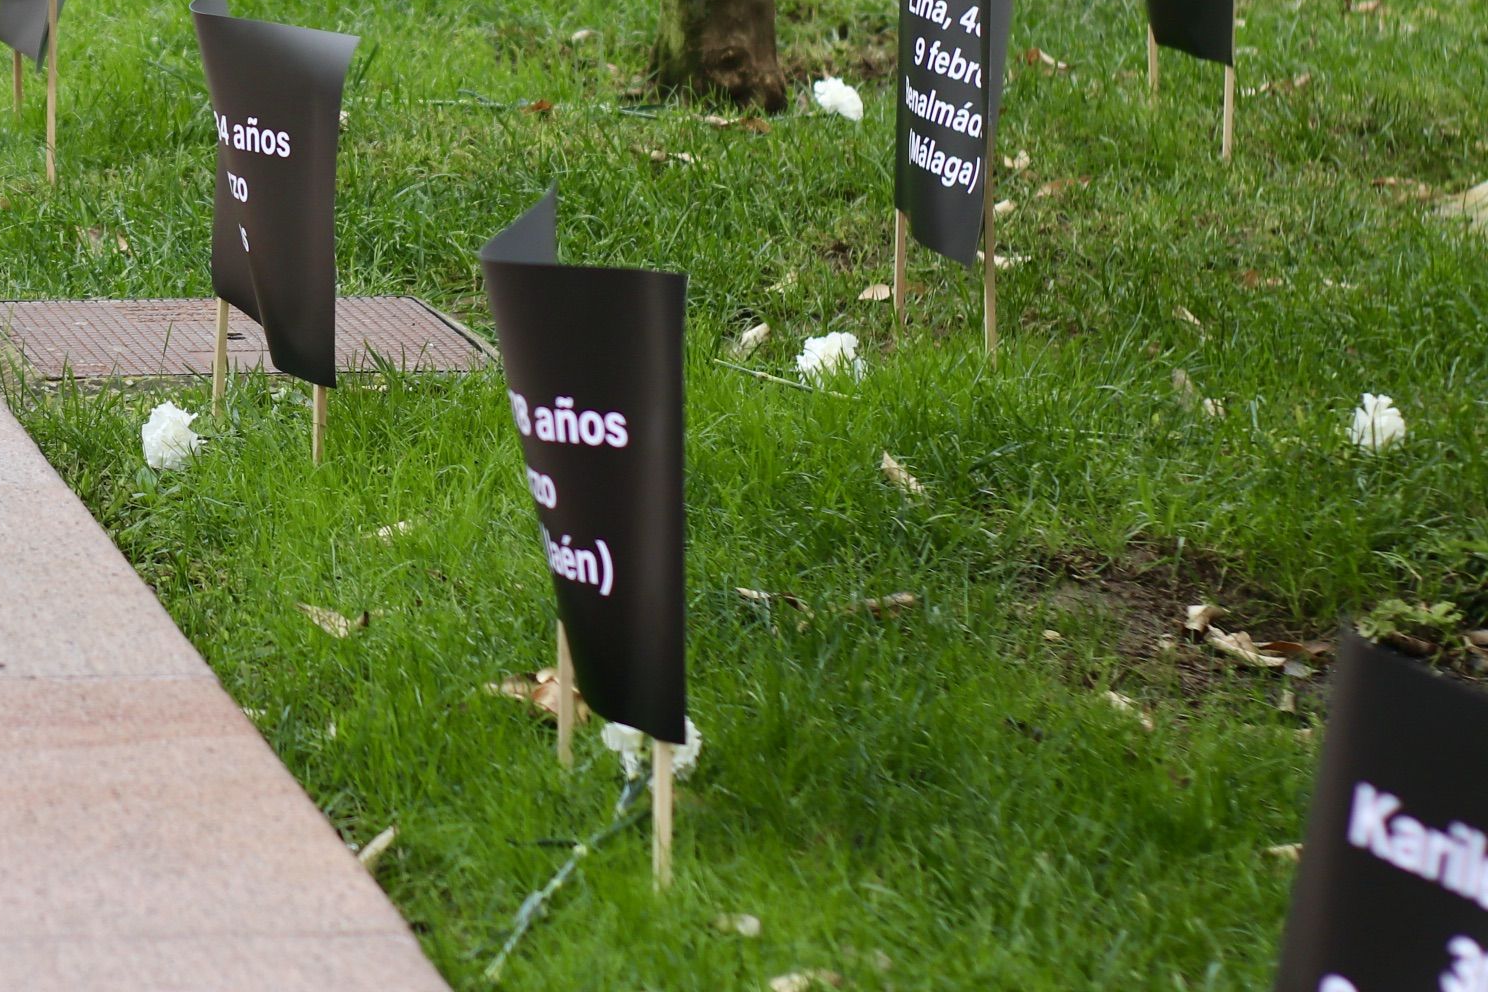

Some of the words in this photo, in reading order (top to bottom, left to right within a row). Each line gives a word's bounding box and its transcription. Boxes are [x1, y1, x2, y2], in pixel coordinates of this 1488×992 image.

[914, 36, 926, 66] 9
[233, 116, 292, 158] años
[908, 127, 981, 195] (Málaga)
[534, 395, 629, 448] años
